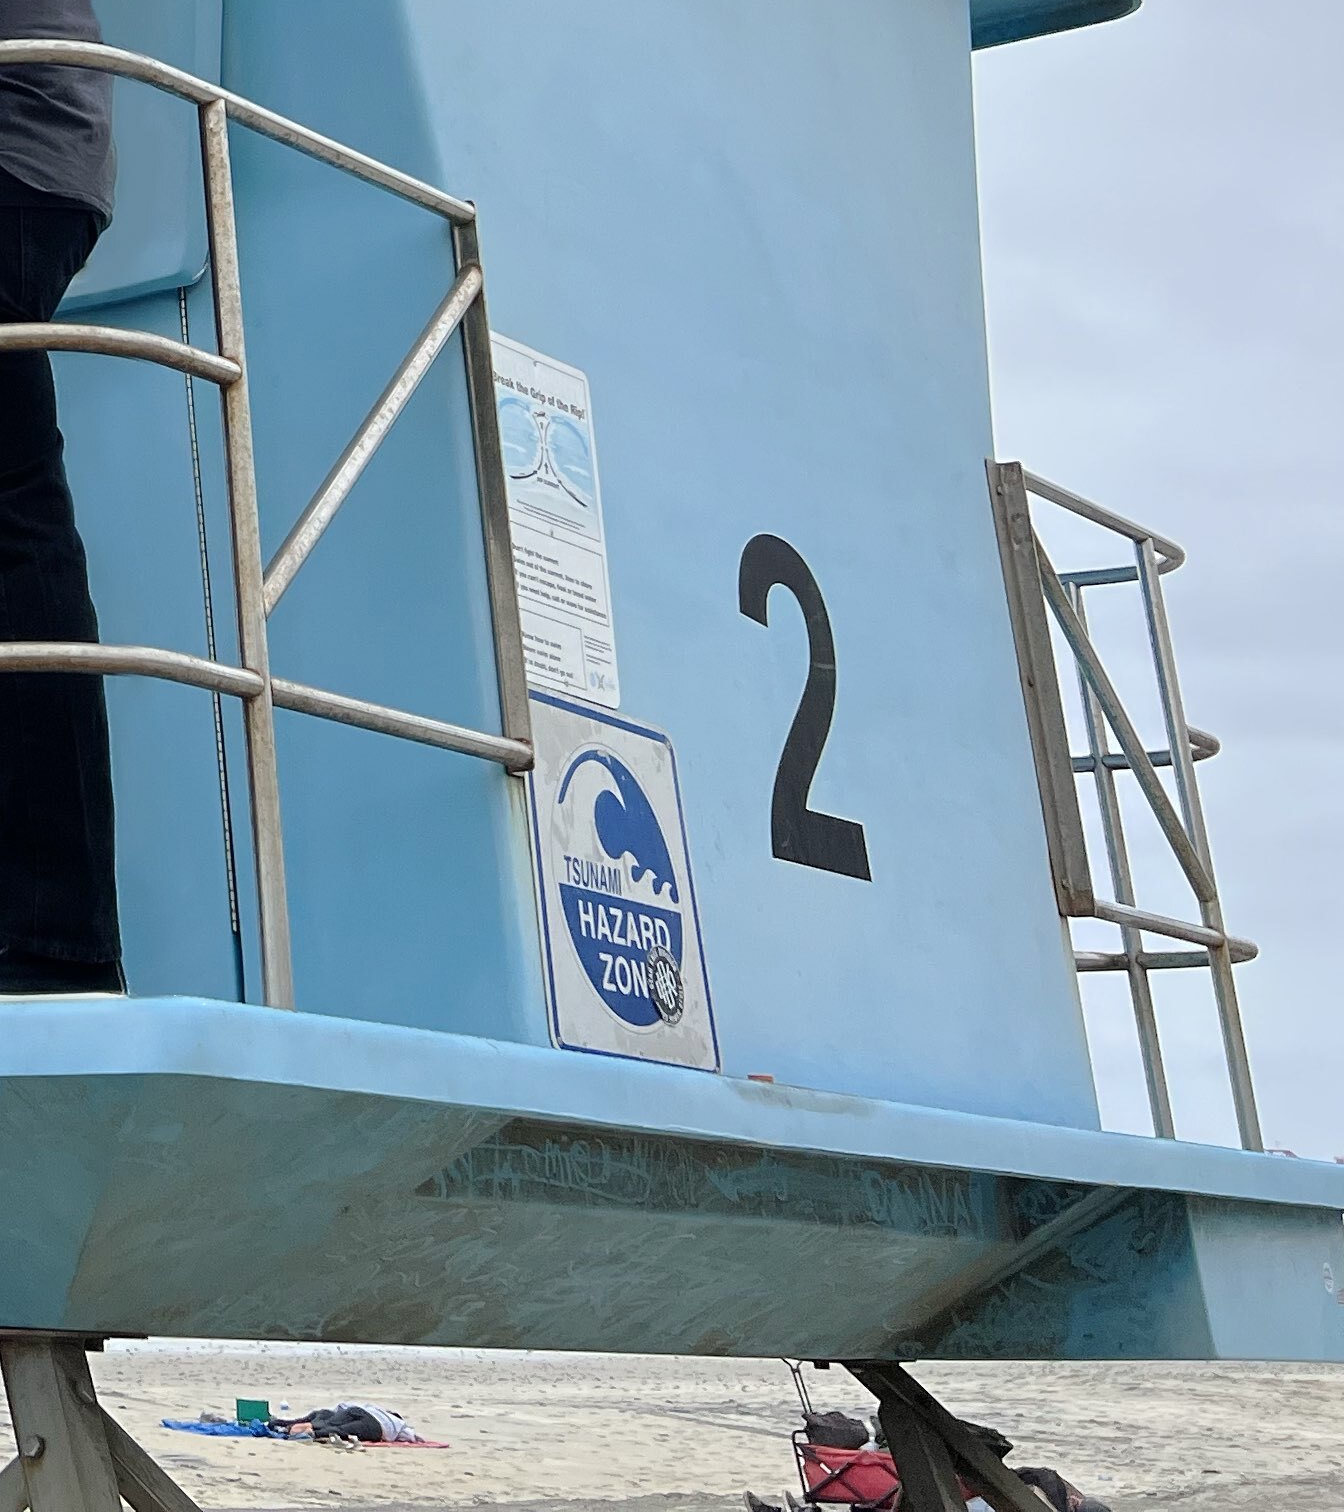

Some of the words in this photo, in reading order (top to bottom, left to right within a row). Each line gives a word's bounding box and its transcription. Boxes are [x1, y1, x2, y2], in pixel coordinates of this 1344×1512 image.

[738, 533, 872, 882] 2
[563, 854, 622, 896] TSUNAMI
[577, 898, 672, 952] HAZARD
[598, 951, 650, 999] ZON
